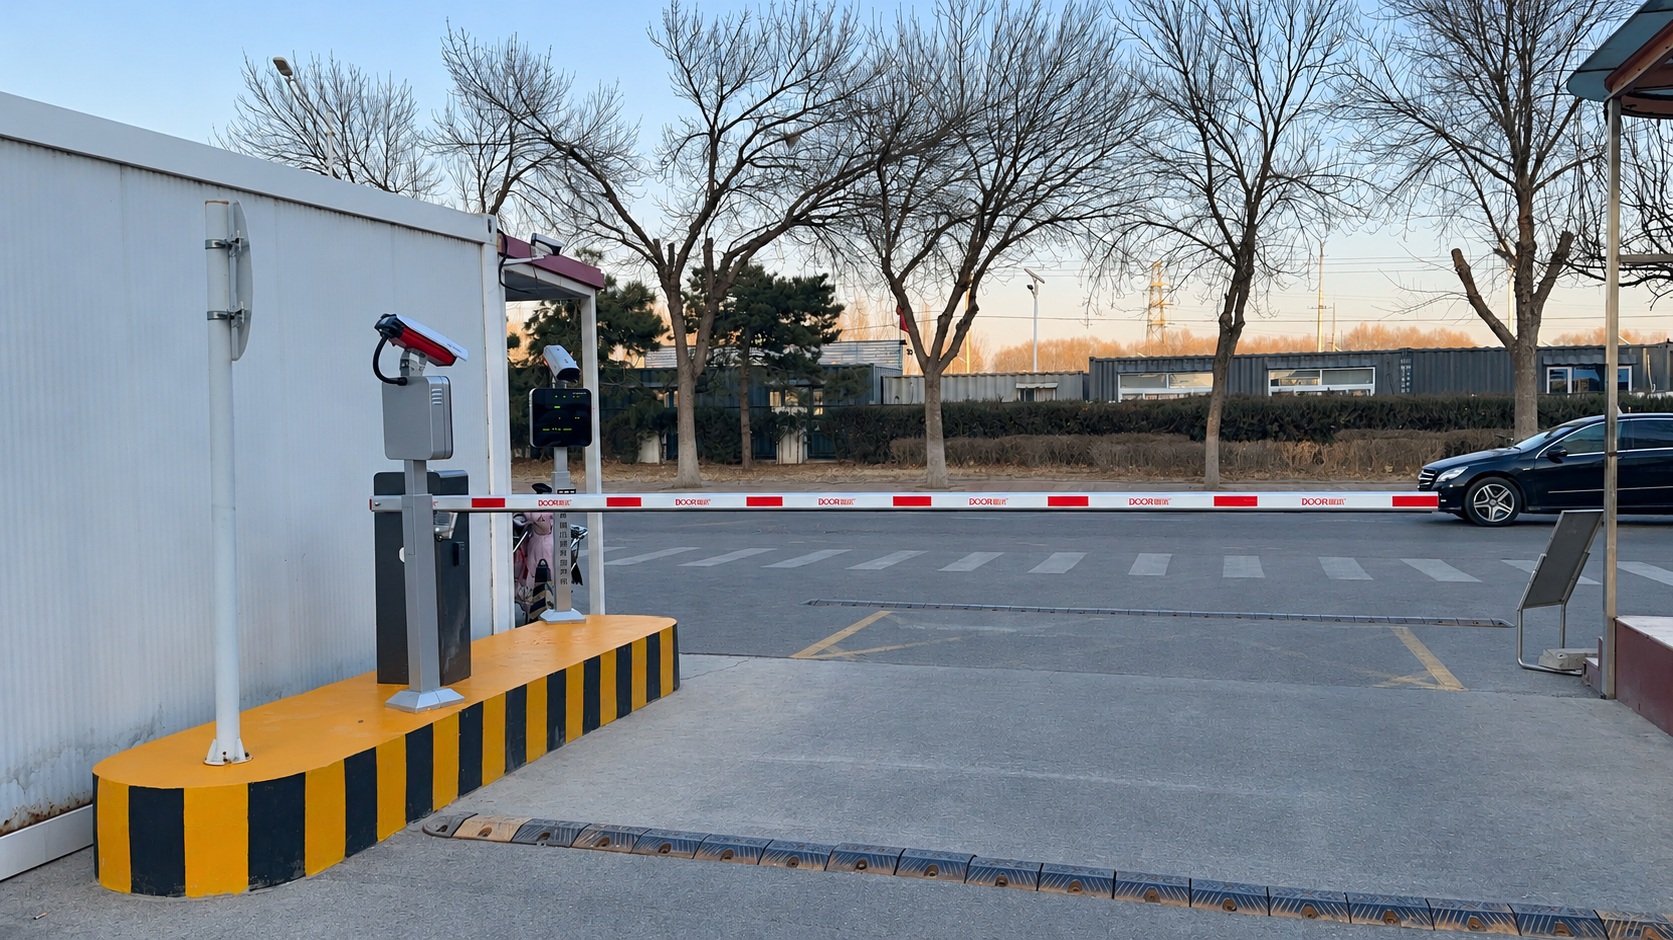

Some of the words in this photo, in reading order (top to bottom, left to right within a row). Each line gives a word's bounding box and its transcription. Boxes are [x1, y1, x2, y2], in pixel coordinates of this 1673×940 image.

[675, 498, 696, 506] DOOR
[818, 498, 840, 506] DOOR
[1129, 498, 1153, 506] DOOR
[1301, 498, 1328, 506] DOOR
